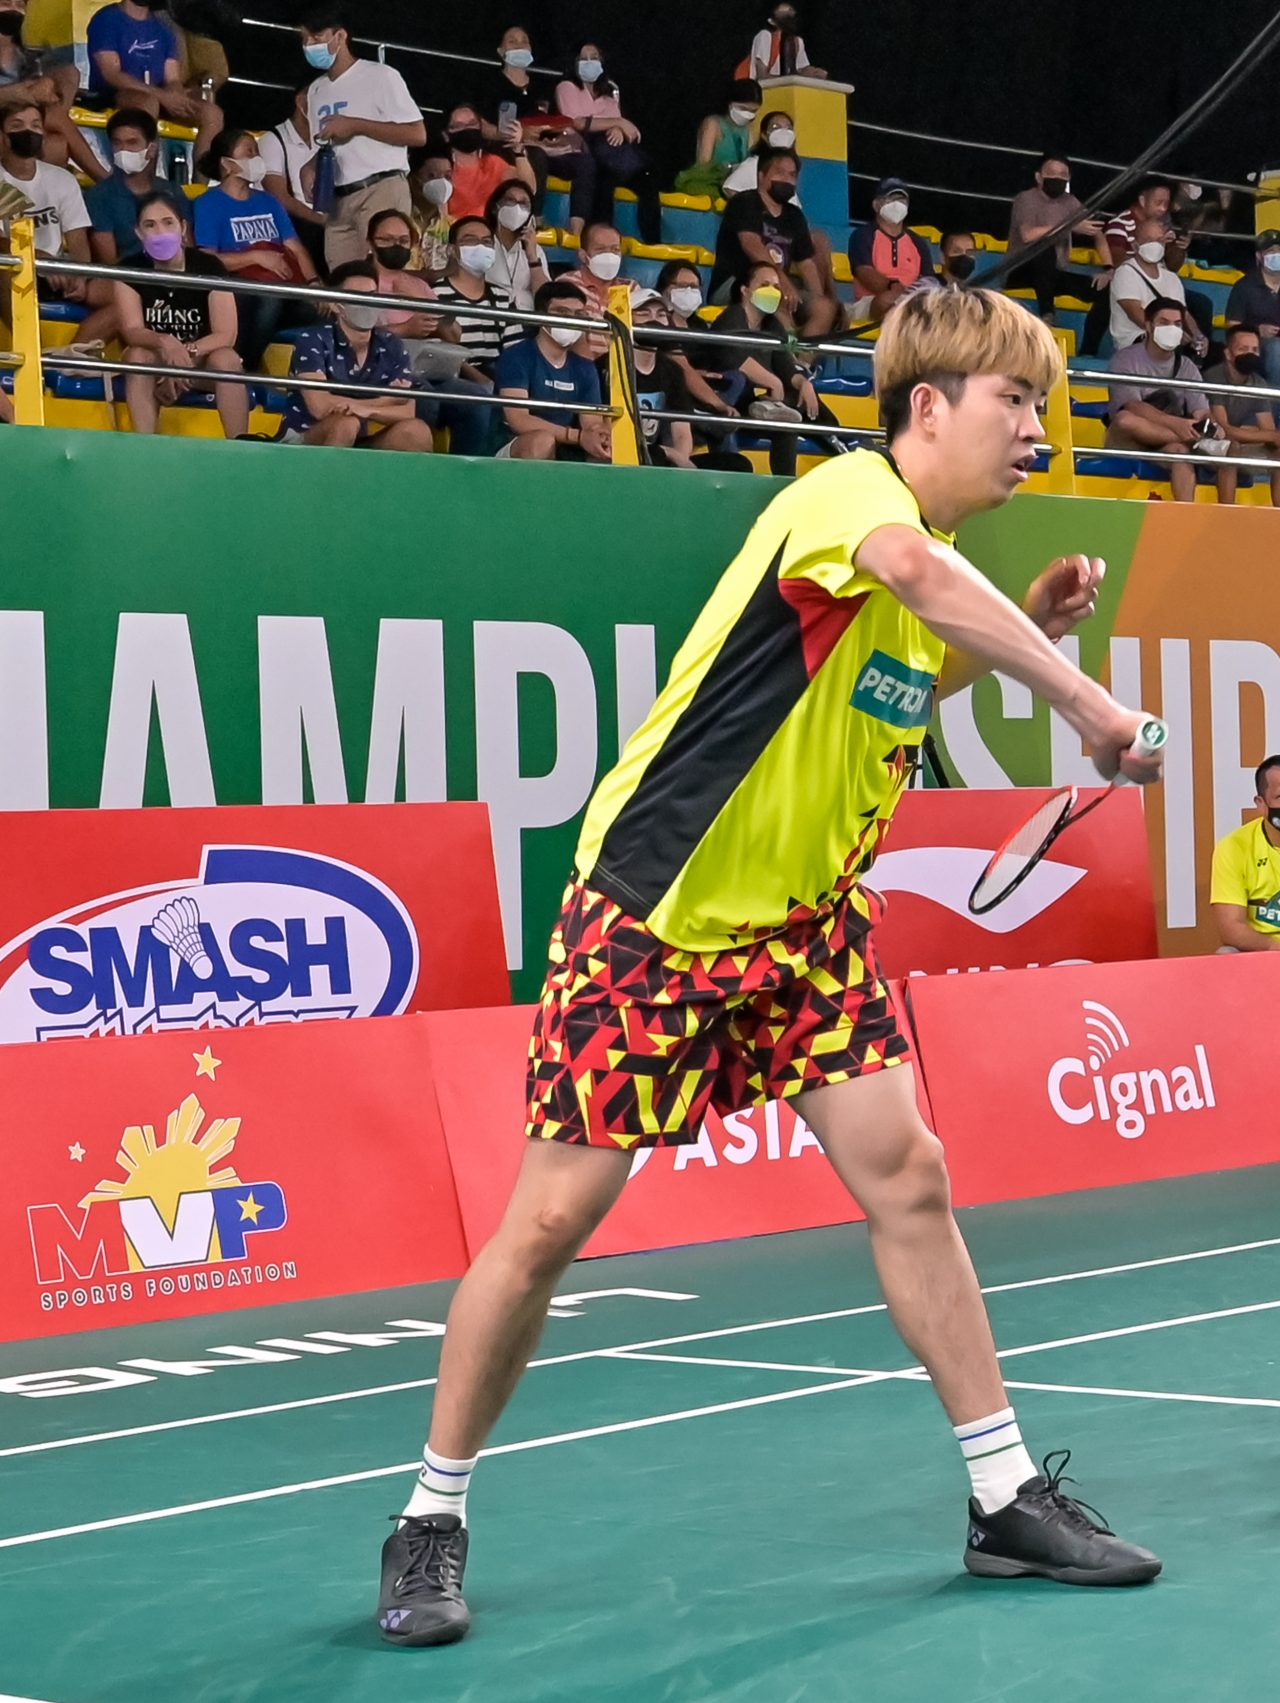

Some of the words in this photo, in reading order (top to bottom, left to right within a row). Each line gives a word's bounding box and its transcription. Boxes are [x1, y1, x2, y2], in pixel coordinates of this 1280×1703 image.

[146, 308, 201, 324] BLING
[29, 916, 352, 1015] SMASH
[1047, 1044, 1217, 1140] Cignal
[26, 1181, 288, 1286] MVP
[40, 1282, 133, 1311] SPORTS
[146, 1261, 298, 1297] FOUNDATION
